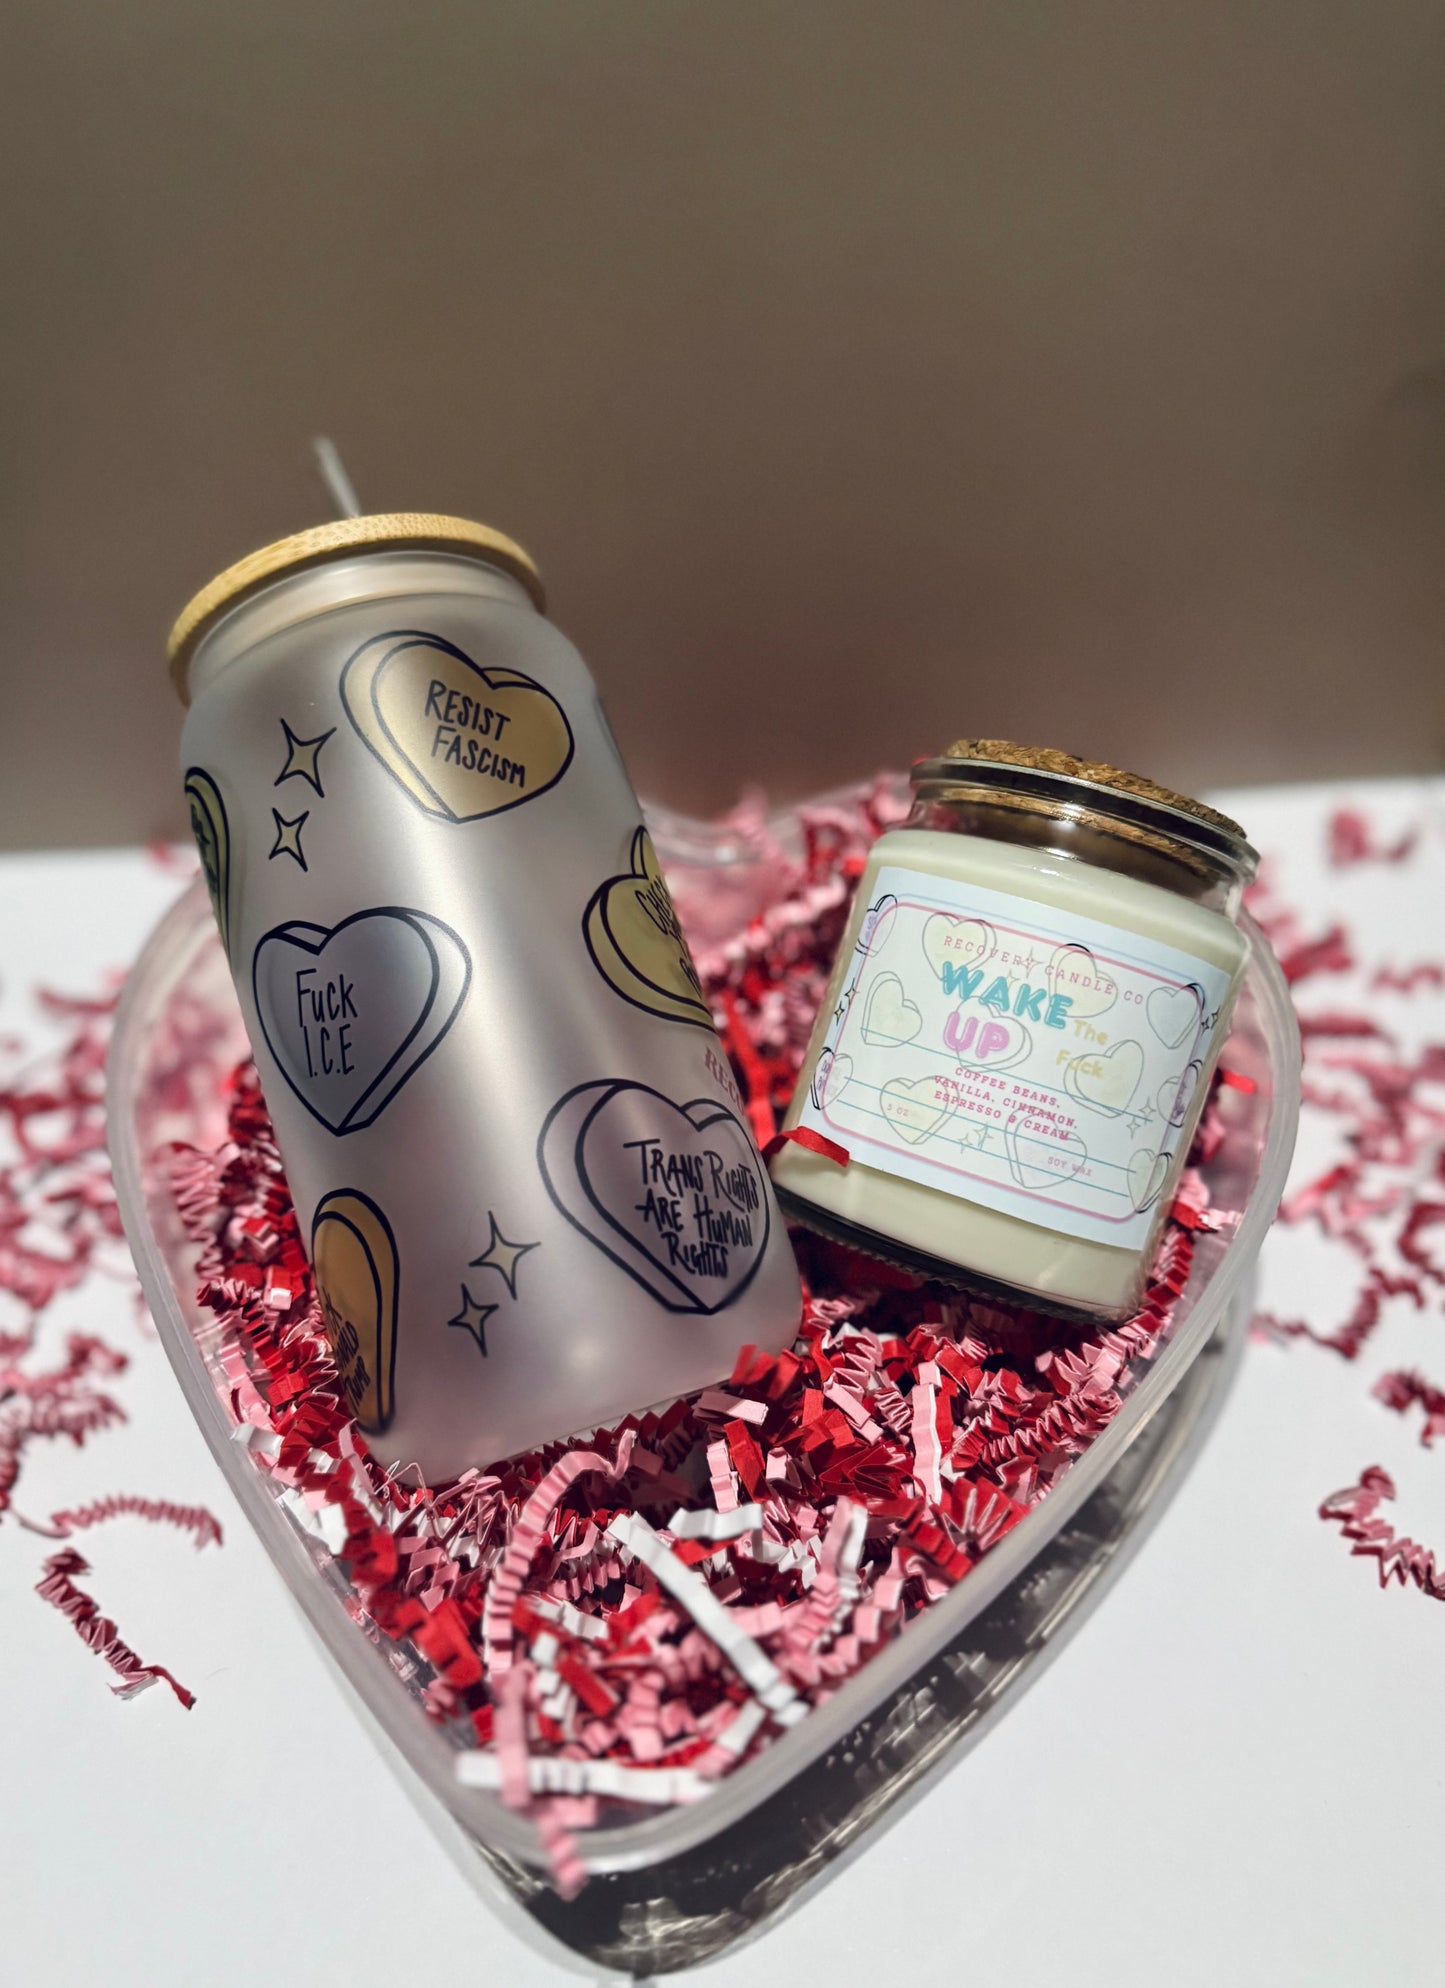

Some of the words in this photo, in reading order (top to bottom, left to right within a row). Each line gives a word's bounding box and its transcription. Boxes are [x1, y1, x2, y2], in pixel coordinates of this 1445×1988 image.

[425, 679, 511, 741] RESIST
[431, 725, 525, 788] FASCISM
[942, 961, 1074, 1030] WAKE
[944, 935, 1034, 970] RECOVERY
[1044, 964, 1115, 995] CANDLE
[1122, 990, 1144, 1005] CO
[296, 968, 358, 1028] Fuck
[942, 1011, 1010, 1059] UP
[1074, 1019, 1108, 1046] The
[955, 1067, 1006, 1090] COFFEE
[1056, 1049, 1103, 1078] Fuck
[934, 1090, 1002, 1119] ESPRESSO
[1008, 1114, 1017, 1124] &
[1024, 1120, 1070, 1141] CREAM
[623, 1138, 704, 1198] TRANS
[635, 1188, 685, 1233] ARE
